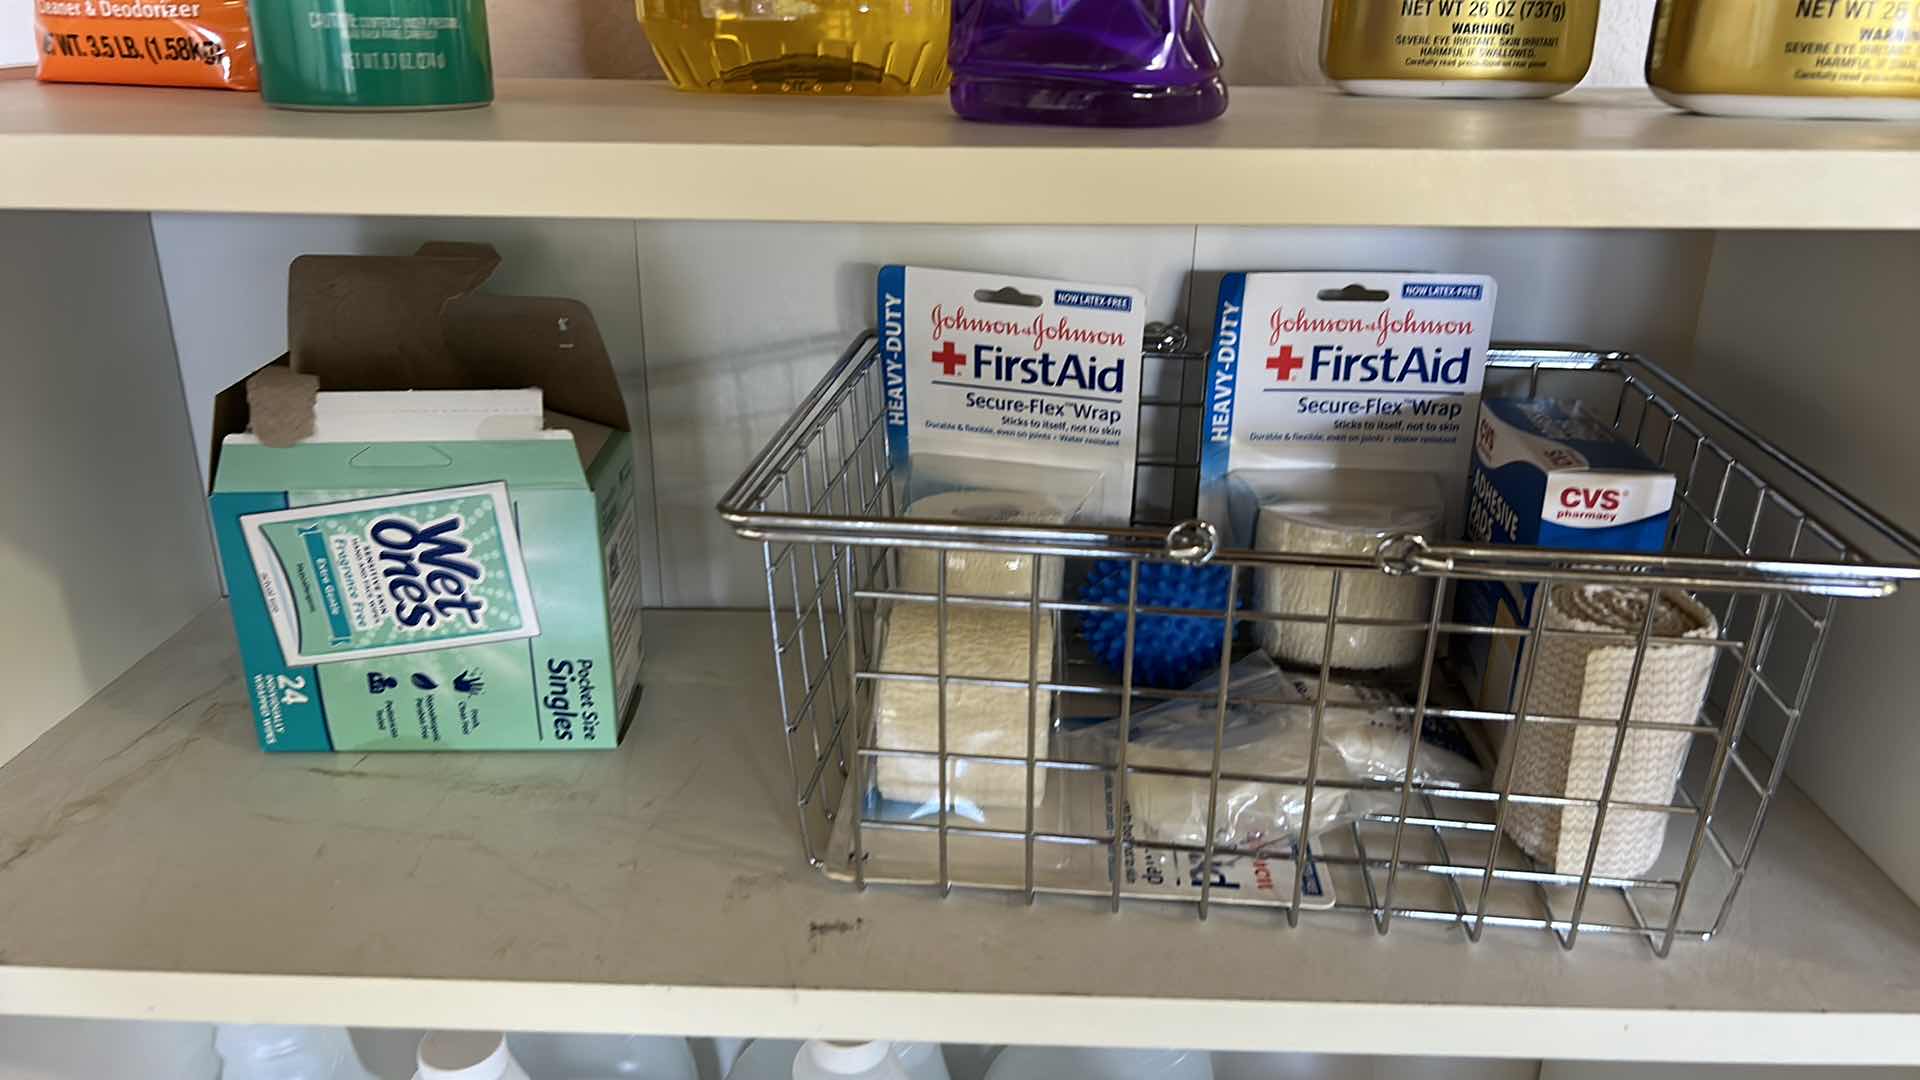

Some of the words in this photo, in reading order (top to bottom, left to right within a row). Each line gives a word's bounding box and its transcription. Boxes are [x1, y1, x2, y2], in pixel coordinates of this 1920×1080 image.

[99, 0, 200, 17] Deodorizer
[1401, 0, 1433, 17] NET
[1439, 0, 1464, 17] WT
[1469, 1, 1489, 17] 26
[1495, 1, 1516, 18] OZ
[1520, 2, 1566, 21] (737g)
[1795, 0, 1838, 18] NET
[1452, 23, 1514, 35] WARNING!
[57, 33, 87, 56] WT.
[86, 34, 114, 57] 3.5
[114, 36, 144, 59] LB.
[145, 36, 223, 65] (1.58kg)
[1784, 41, 1831, 54] SEVERE
[1056, 292, 1079, 305] NOW
[1080, 295, 1129, 312] LATEX-FREE
[1405, 286, 1429, 297] NOW
[1429, 286, 1480, 299] LATEX-FREE
[886, 293, 905, 426] HEAVY-DUTY
[1211, 301, 1240, 442] HEAVY-DUTY
[1073, 403, 1121, 425] Wrap
[1411, 400, 1462, 419] Wrap
[1001, 415, 1029, 428] Sticks
[1029, 418, 1041, 428] to
[1070, 423, 1086, 433] not
[1087, 425, 1099, 436] to
[1101, 426, 1122, 438] skin
[1333, 419, 1361, 430] Sticks
[1363, 421, 1375, 430] to
[1406, 422, 1422, 431] not
[1425, 423, 1438, 431] to
[1439, 422, 1460, 432] skin
[1472, 466, 1519, 542] ADHESIVE
[1560, 487, 1620, 511] CVS
[1556, 511, 1617, 522] pharmacy
[333, 538, 359, 599] Fragrance
[352, 602, 367, 628] Free
[371, 519, 437, 628] Ones
[419, 517, 481, 625] Wet
[316, 557, 330, 584] Extra
[324, 584, 341, 616] Gentle
[277, 675, 309, 705] 24
[577, 659, 596, 708] Pocket
[543, 659, 579, 741] Singles
[582, 710, 601, 741] Size
